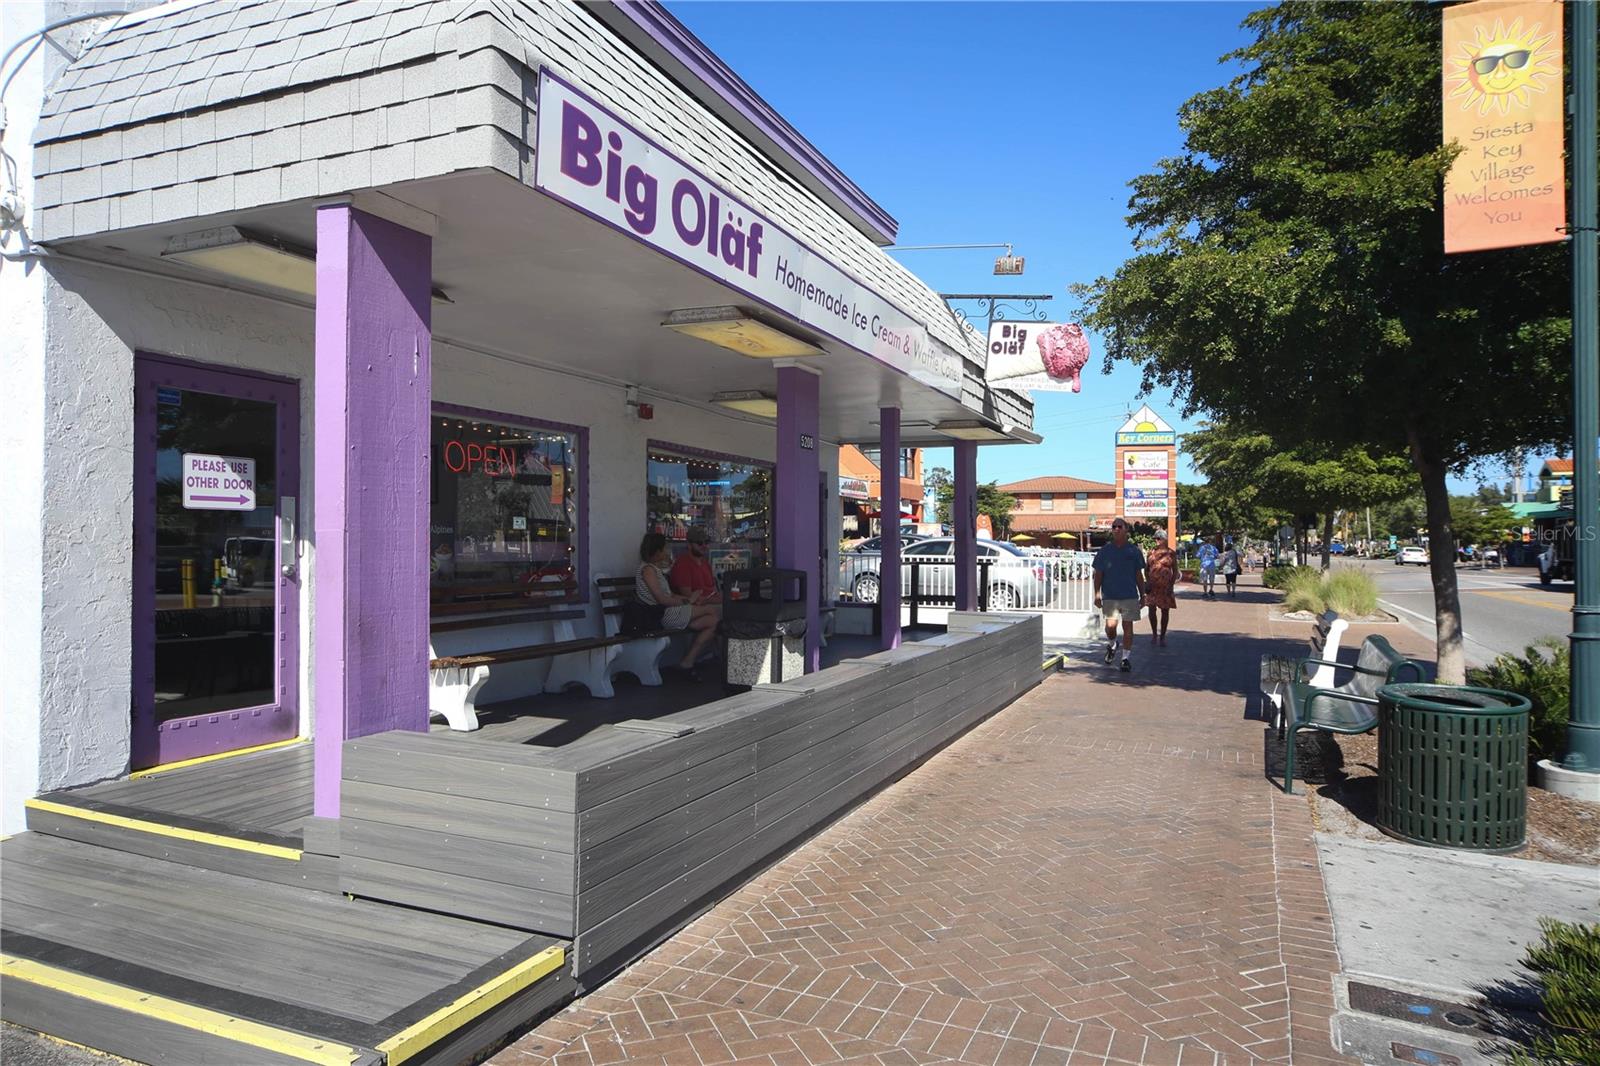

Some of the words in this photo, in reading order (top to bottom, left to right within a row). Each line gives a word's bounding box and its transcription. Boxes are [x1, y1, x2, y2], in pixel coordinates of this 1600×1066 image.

[1470, 122, 1534, 141] Siesta
[1483, 144, 1522, 163] Key
[1471, 162, 1535, 184] Village
[560, 99, 658, 235] Big
[671, 178, 764, 278] Oläf
[1455, 184, 1553, 206] Welcomes
[1484, 211, 1522, 224] You
[775, 255, 848, 321] Homemade
[851, 302, 868, 331] Ice
[871, 315, 901, 350] Cream
[903, 334, 910, 355] &
[914, 340, 939, 372] Waffle
[941, 359, 960, 383] Cones
[1002, 324, 1027, 342] Big
[801, 435, 814, 449] 5208
[192, 459, 226, 473] PLEASE
[231, 462, 248, 474] USE
[444, 440, 517, 480] OPEN
[187, 476, 219, 489] OTHER
[224, 478, 253, 490] DOOR
